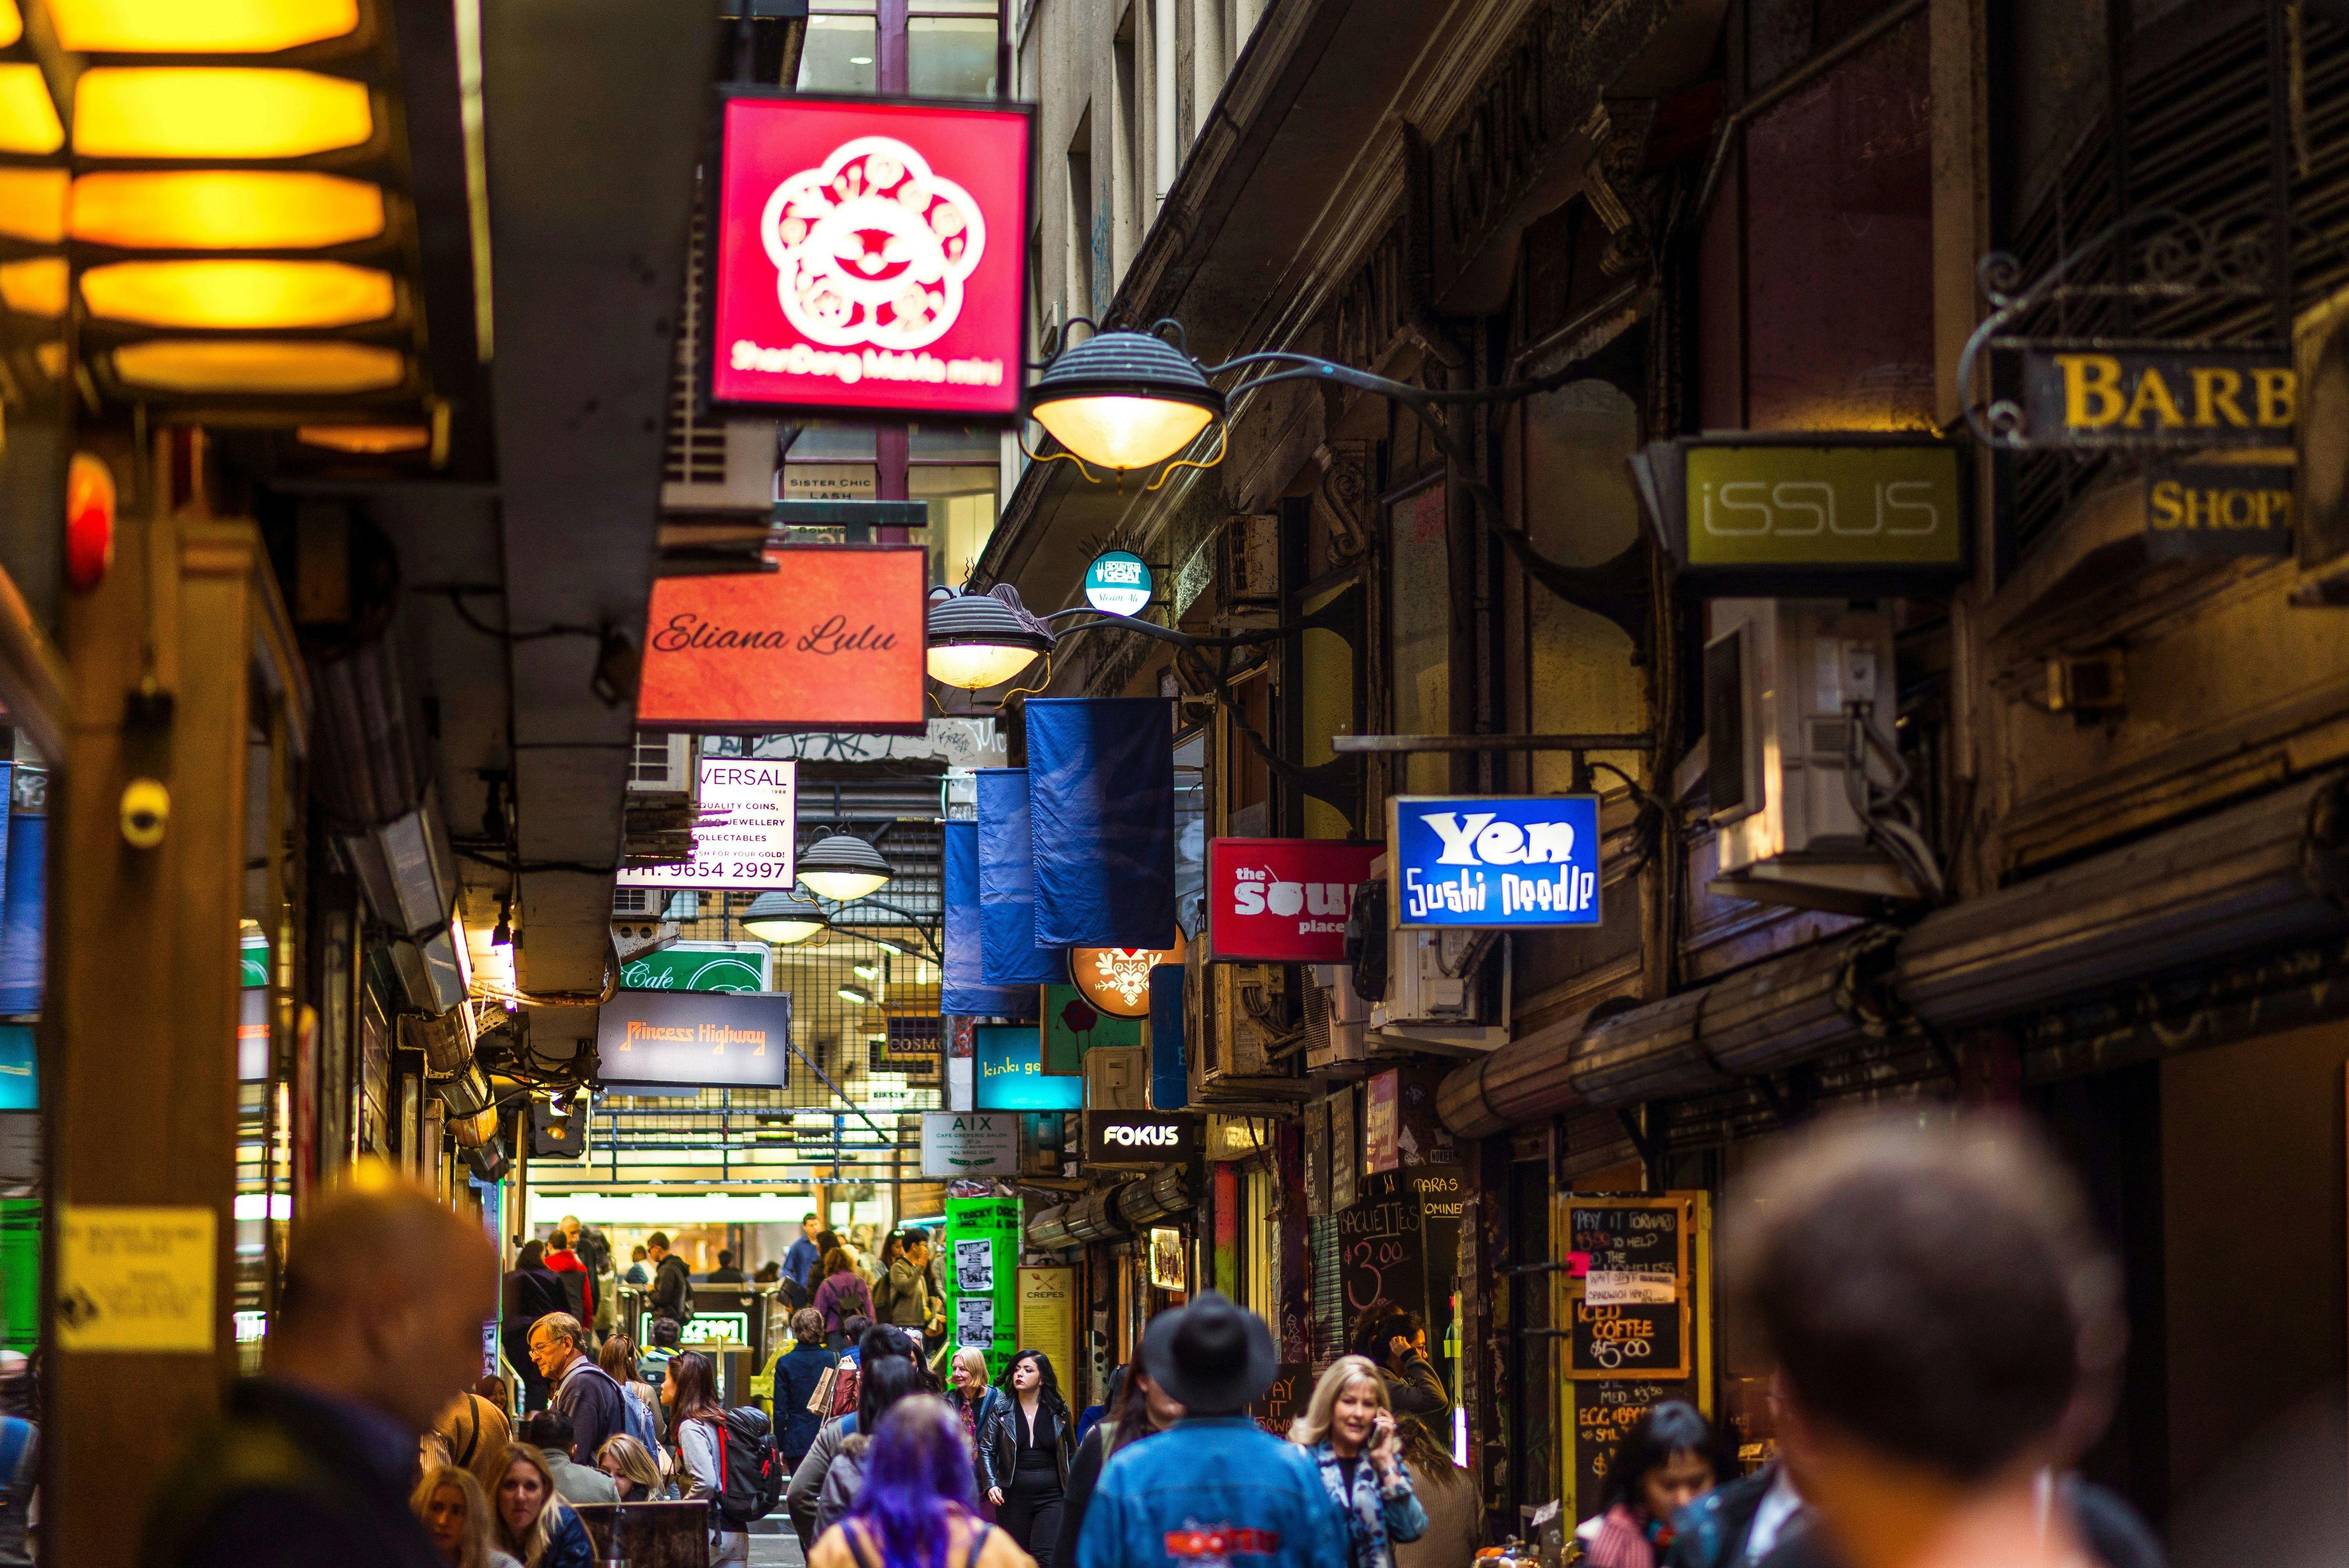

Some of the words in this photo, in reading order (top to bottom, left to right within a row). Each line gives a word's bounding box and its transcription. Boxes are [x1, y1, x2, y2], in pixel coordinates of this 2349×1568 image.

[1104, 569, 1141, 582] GOAT
[652, 613, 790, 652] Eliana
[797, 615, 898, 656] Lulu
[746, 803, 779, 811] COINS,
[1420, 812, 1575, 865] Yen
[670, 862, 724, 877] 9654
[733, 862, 785, 878] 2997
[1236, 867, 1266, 880] the
[1407, 868, 1487, 917] Sushi
[1299, 920, 1346, 935] place
[621, 960, 674, 988] Cafe
[619, 1021, 694, 1052] Princess
[699, 1023, 766, 1056] Highway
[952, 1117, 992, 1130] AIX
[1104, 1125, 1178, 1146] FOKUS
[1610, 1212, 1622, 1229] IT
[1627, 1233, 1658, 1247] HELP
[1592, 1319, 1654, 1339] COFFEE
[1262, 1376, 1295, 1400] AY
[1270, 1400, 1288, 1417] IT
